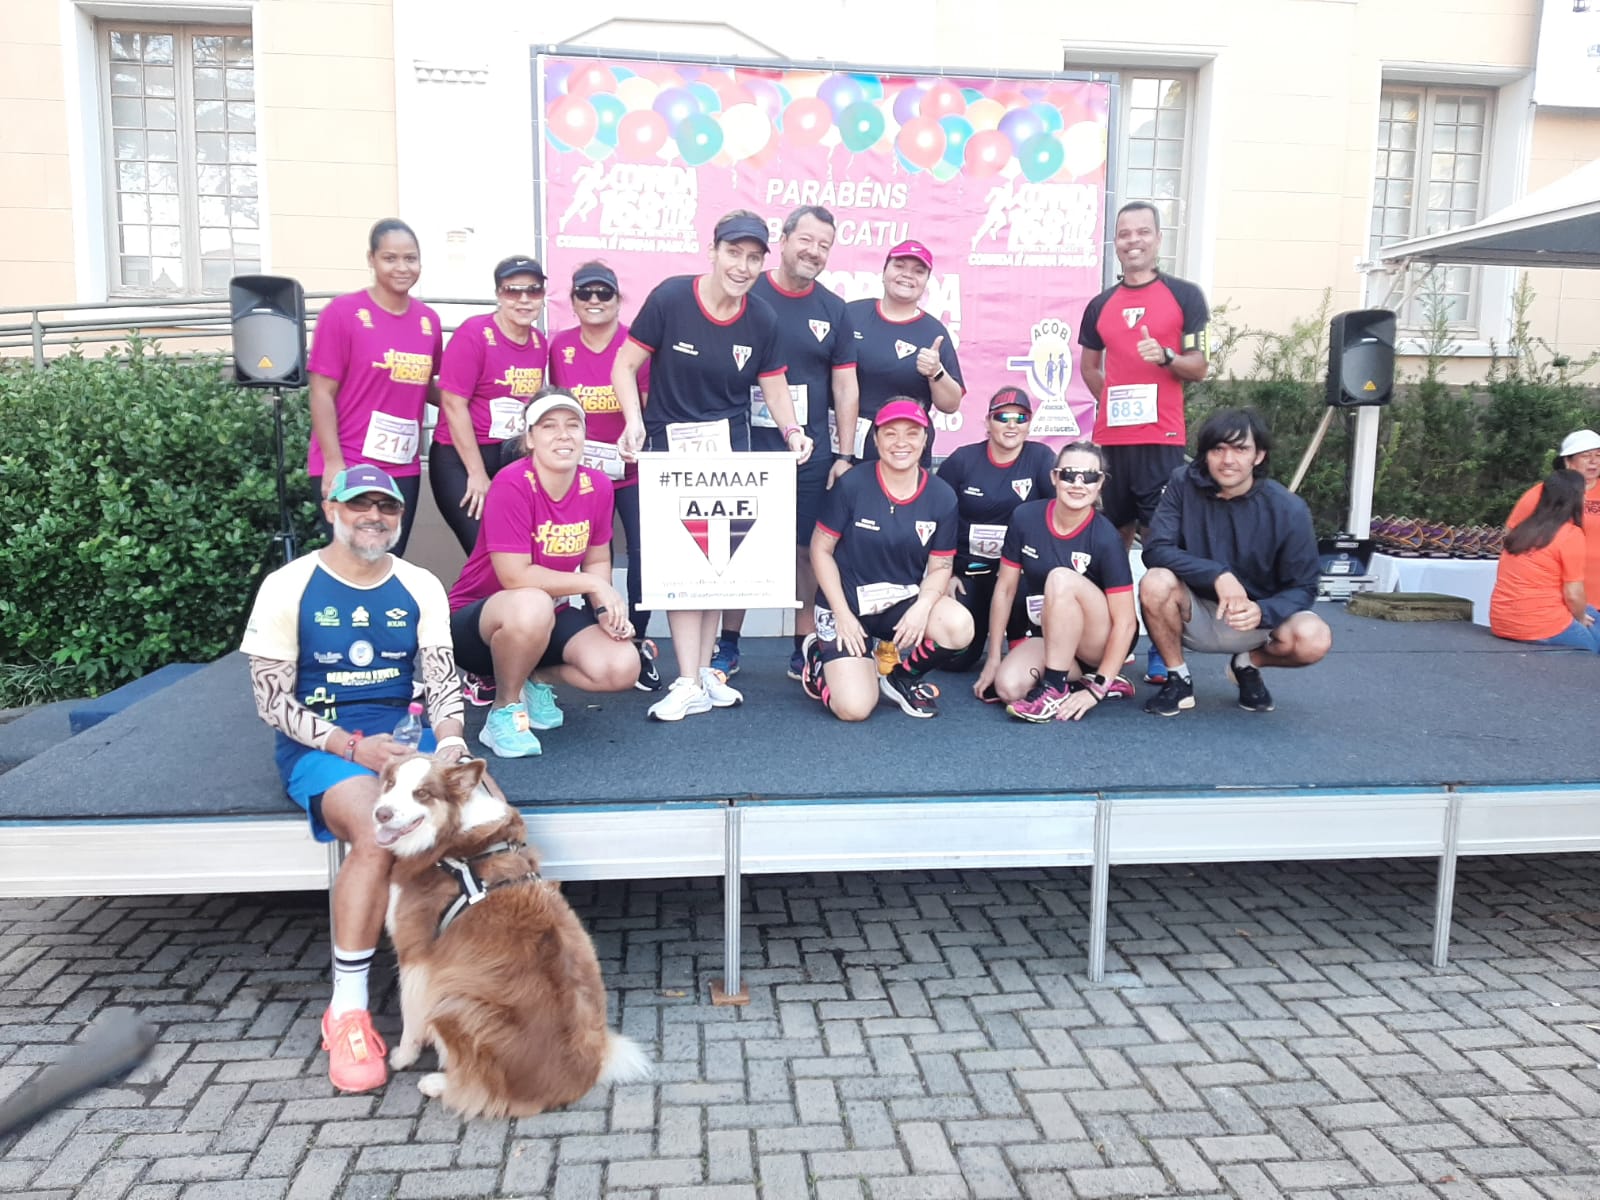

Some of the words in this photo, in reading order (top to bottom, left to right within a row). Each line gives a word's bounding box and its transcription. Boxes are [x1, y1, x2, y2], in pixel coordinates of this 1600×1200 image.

[766, 177, 909, 209] PARABÉNS
[767, 217, 910, 247] BCATU
[1033, 322, 1068, 341] ACOB
[1111, 400, 1144, 418] 683
[373, 433, 411, 455] 214
[659, 471, 769, 488] #TEAMAAF
[685, 500, 753, 517] A.A.F.
